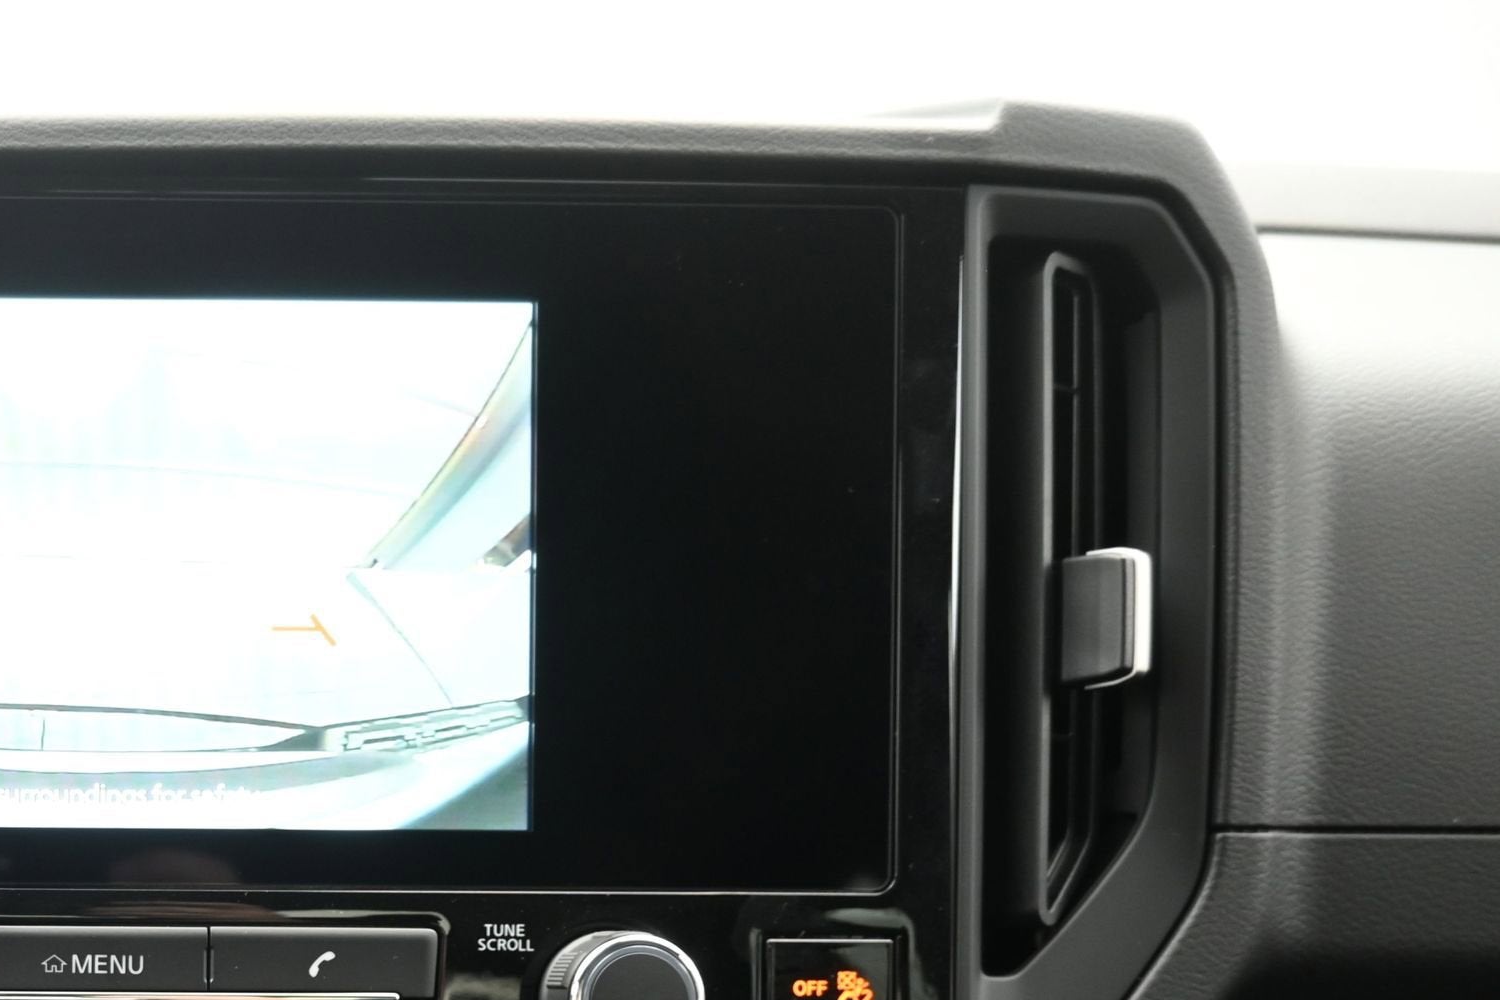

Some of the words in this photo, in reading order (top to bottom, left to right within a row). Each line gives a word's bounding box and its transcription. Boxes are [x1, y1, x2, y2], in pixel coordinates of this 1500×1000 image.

[149, 782, 188, 804] for
[484, 923, 526, 937] TUNE
[477, 938, 535, 952] SCROLL
[71, 953, 145, 975] MENU
[792, 979, 829, 997] OFF
